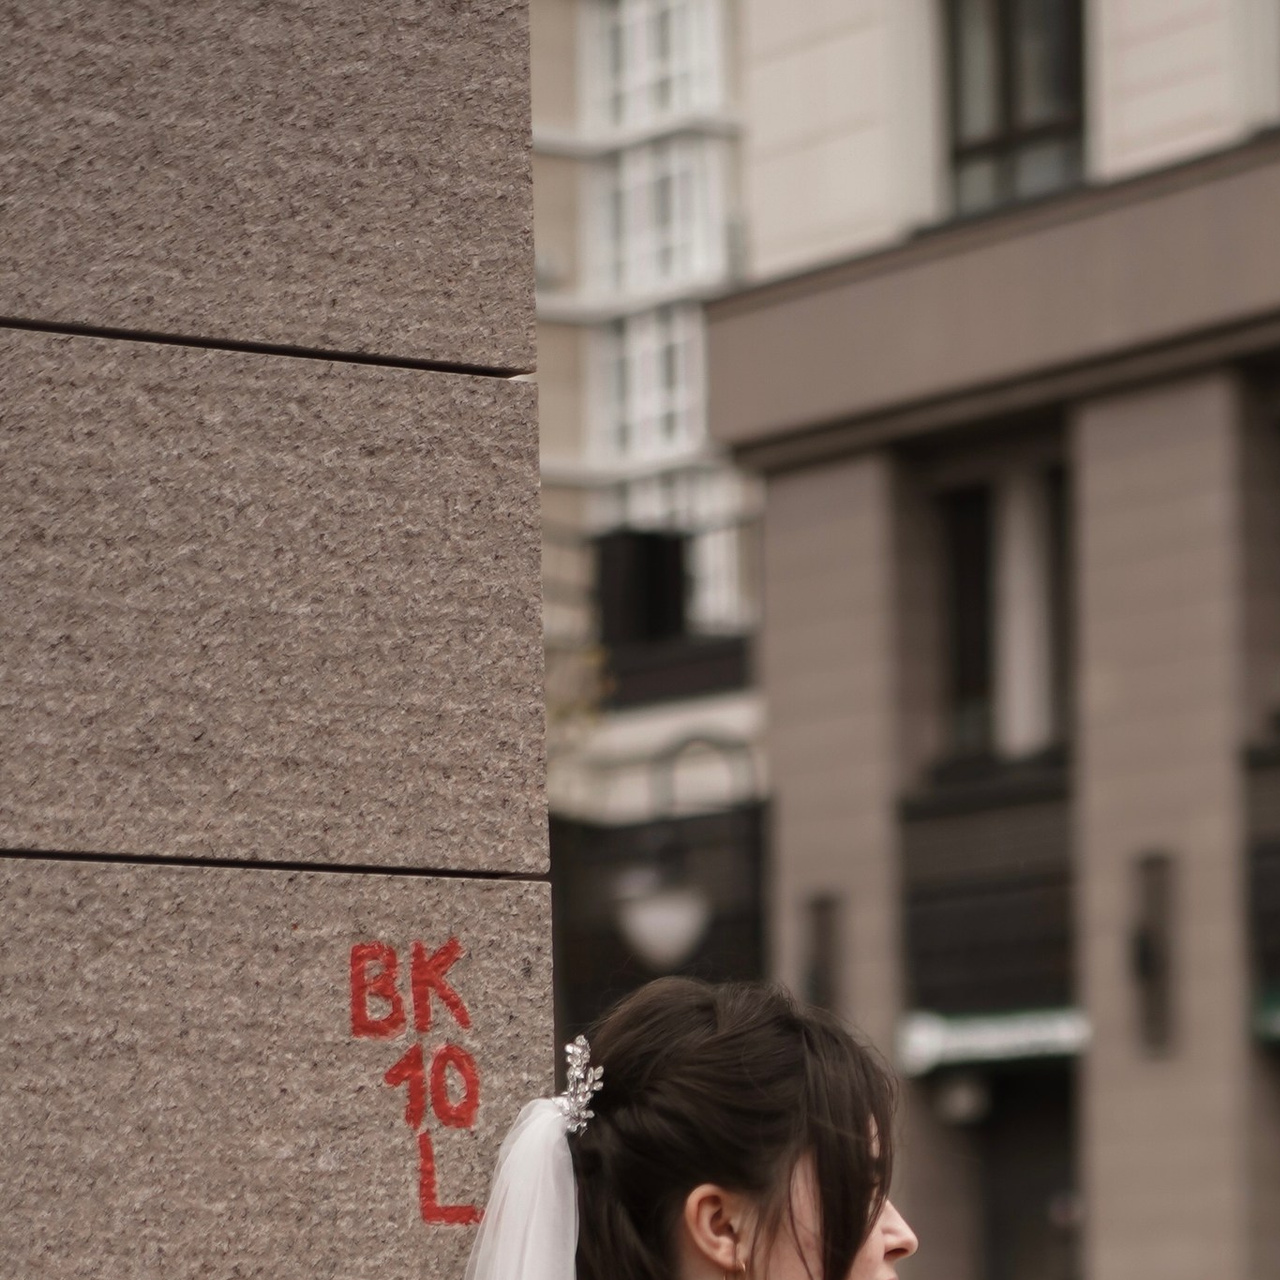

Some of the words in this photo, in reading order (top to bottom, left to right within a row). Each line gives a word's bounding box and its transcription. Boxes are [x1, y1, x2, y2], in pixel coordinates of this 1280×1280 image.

[349, 937, 472, 1040] BK
[383, 1042, 481, 1130] 10
[416, 1131, 486, 1226] L
